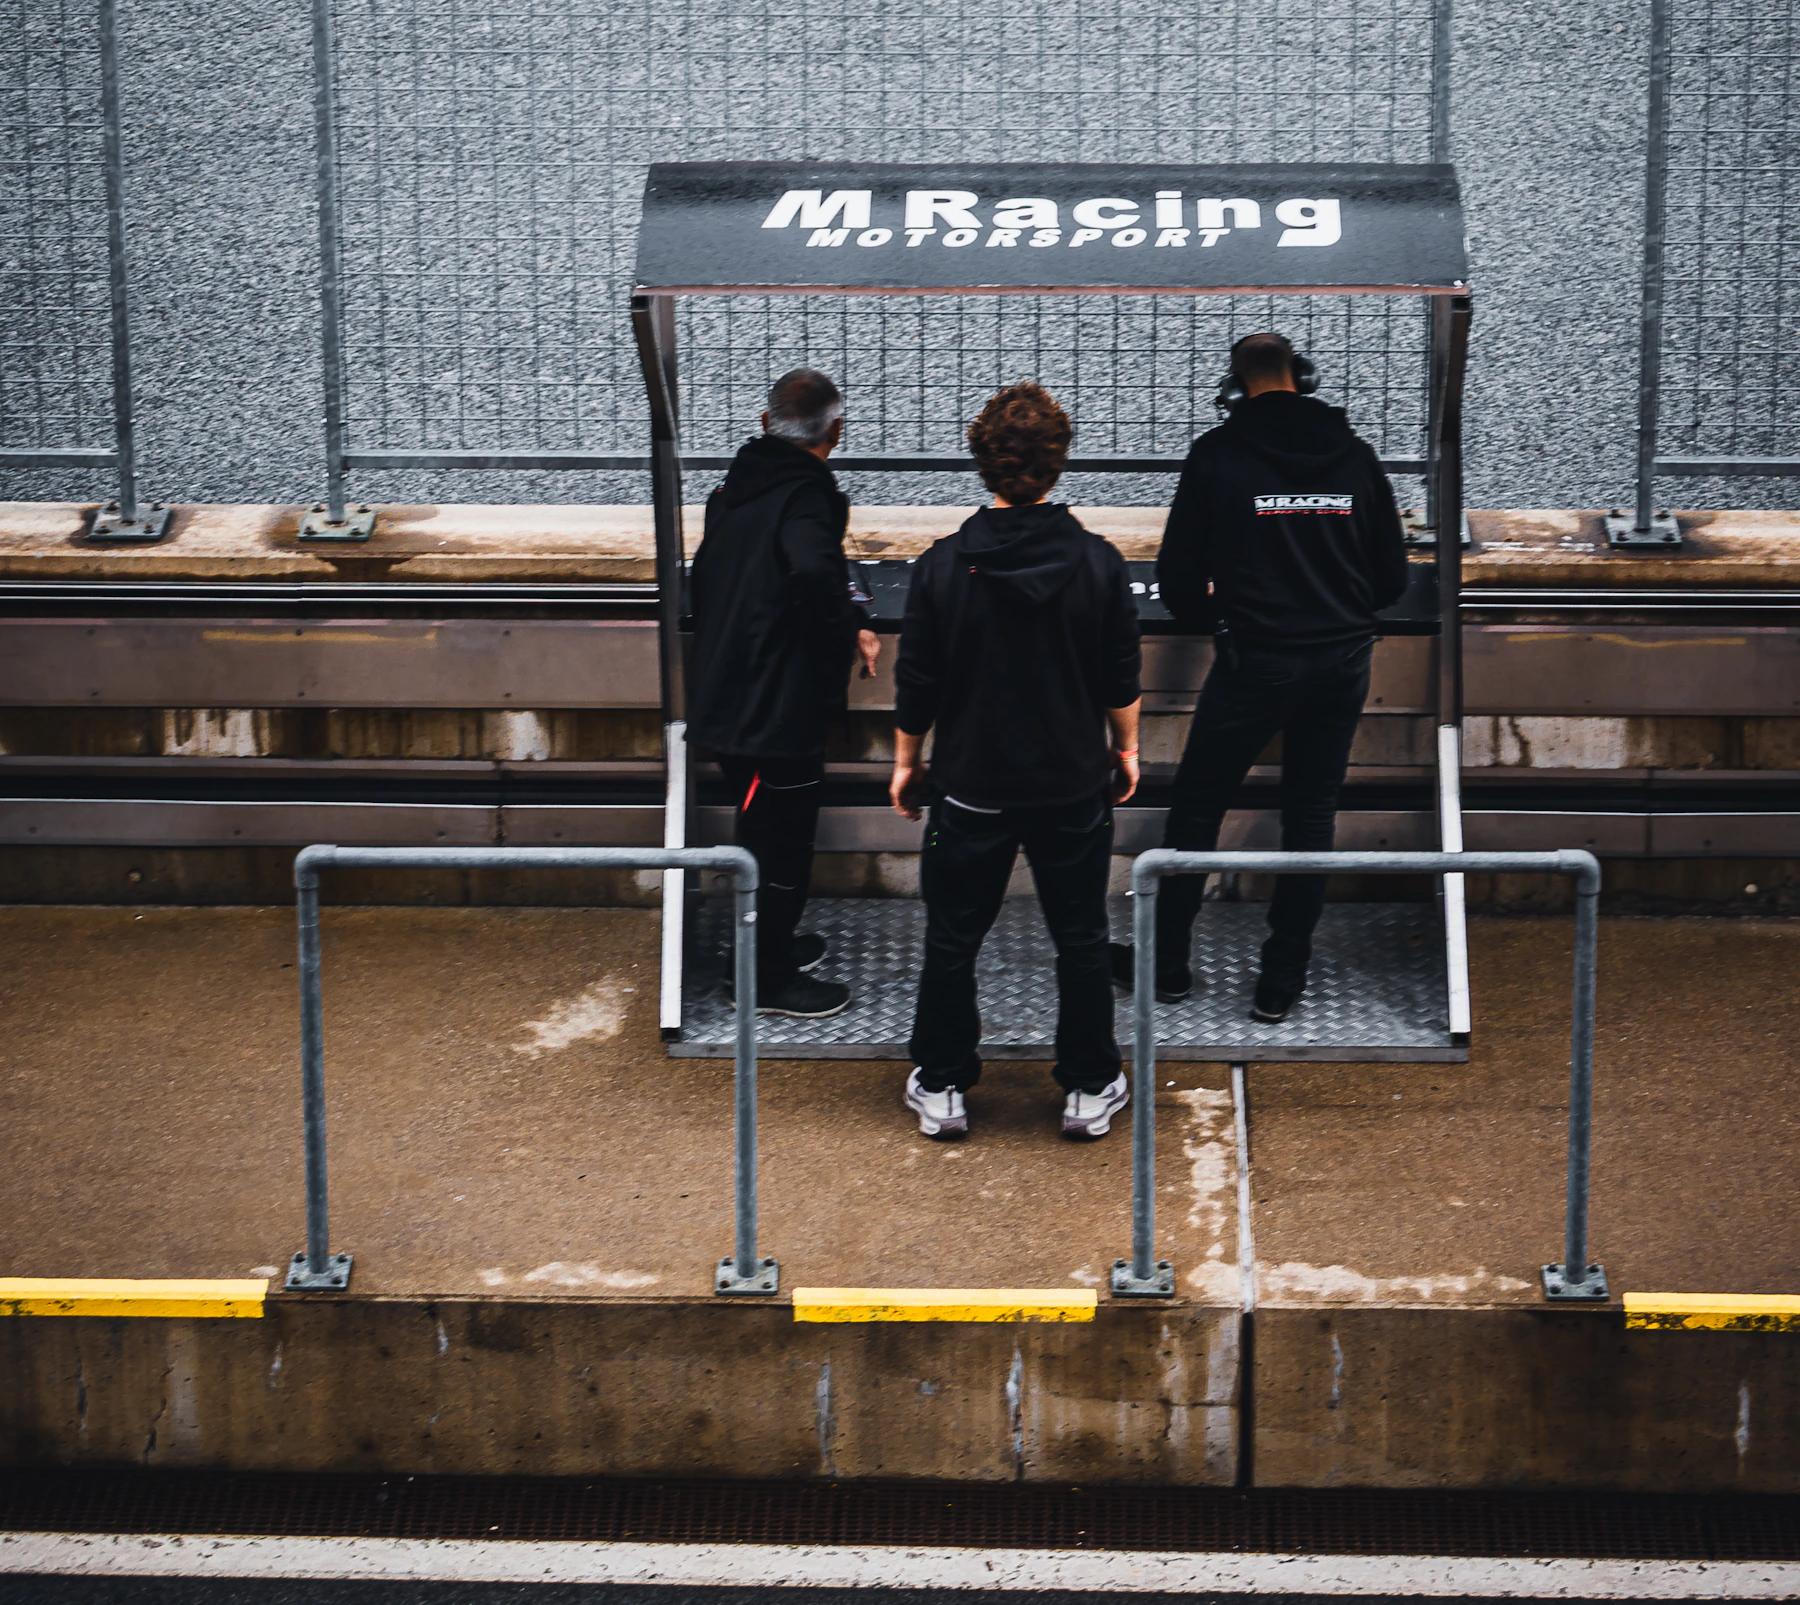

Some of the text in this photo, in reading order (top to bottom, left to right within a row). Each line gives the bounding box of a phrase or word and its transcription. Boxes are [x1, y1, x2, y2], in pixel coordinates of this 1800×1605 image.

[760, 189, 1342, 248] M Racing
[805, 227, 1232, 248] MOTORSPORT
